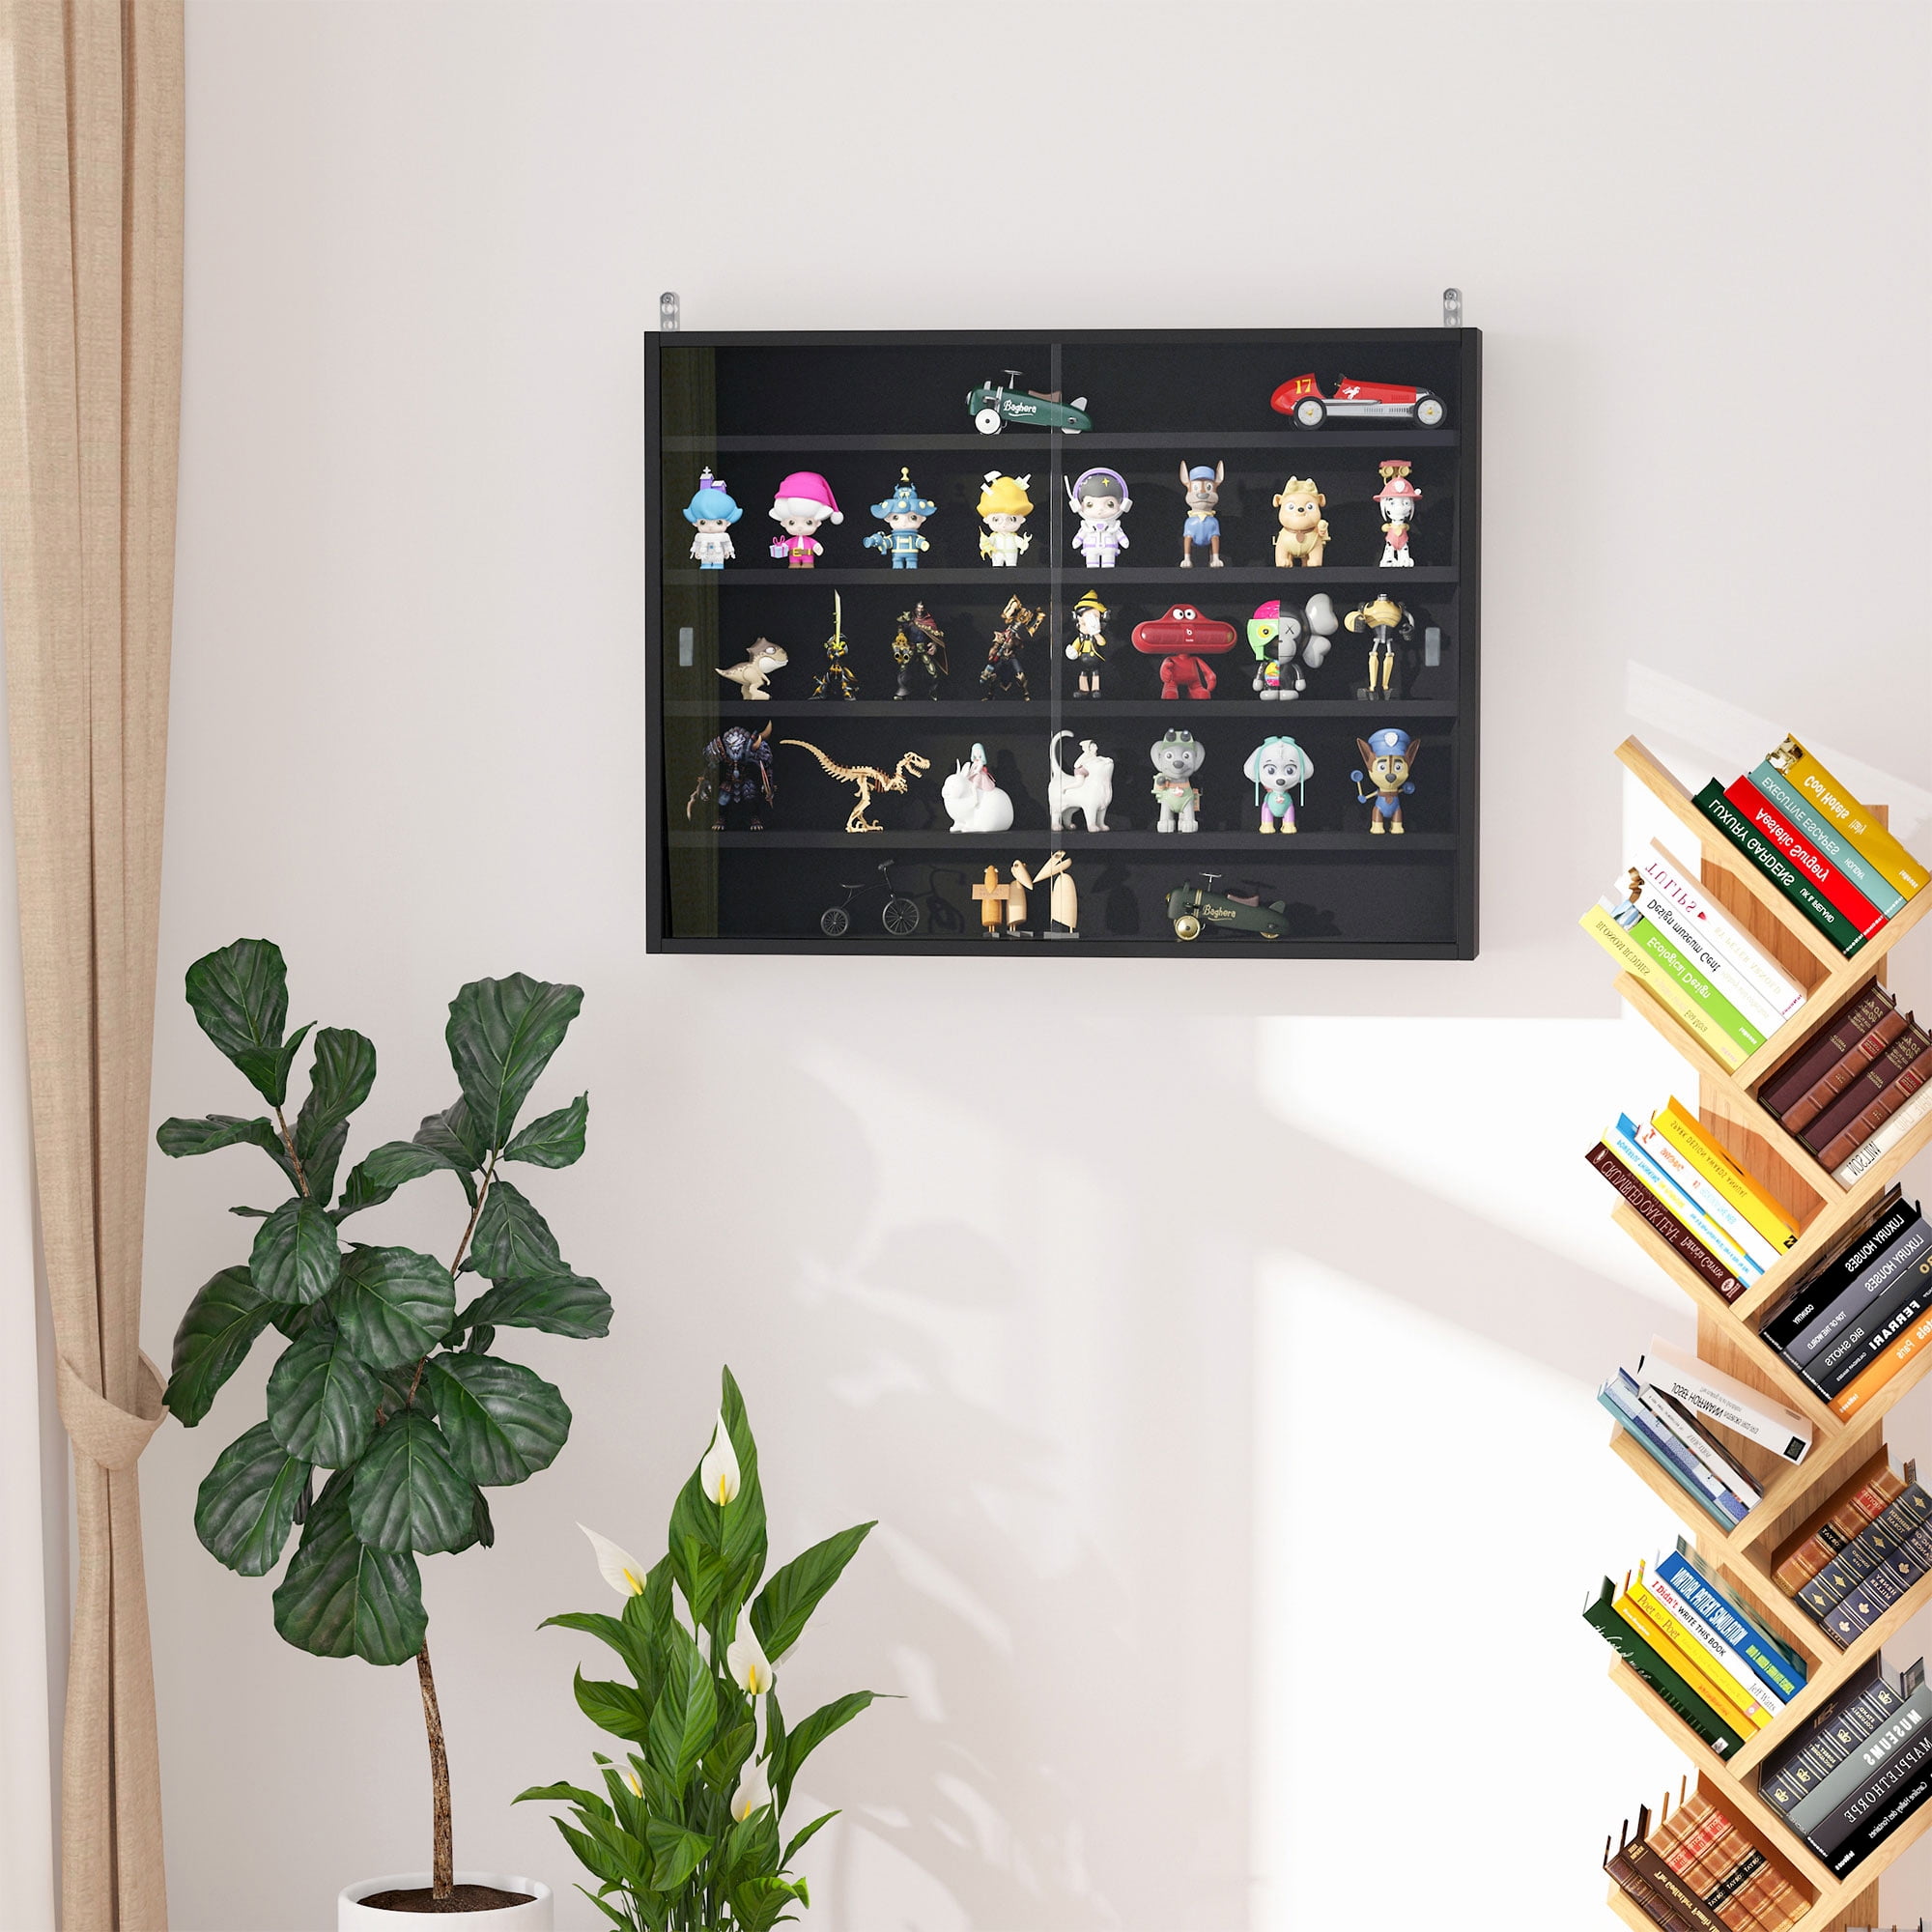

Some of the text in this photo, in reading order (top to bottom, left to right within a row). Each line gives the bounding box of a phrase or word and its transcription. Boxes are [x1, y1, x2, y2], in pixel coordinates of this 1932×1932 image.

[1294, 379, 1311, 394] 17
[1635, 1593, 1658, 1615] Poet
[1660, 1619, 1682, 1640] Poet
[1655, 1585, 1680, 1608] Didn't
[1676, 1605, 1697, 1627] WRITE
[1693, 1623, 1711, 1640] THIS
[1707, 1636, 1726, 1657] BOOK
[1668, 1567, 1703, 1599] VIRTUAL
[1689, 1588, 1721, 1617] PATIENT
[1708, 1606, 1748, 1646] SIMULATION
[1747, 1682, 1778, 1712] Jeff Watts
